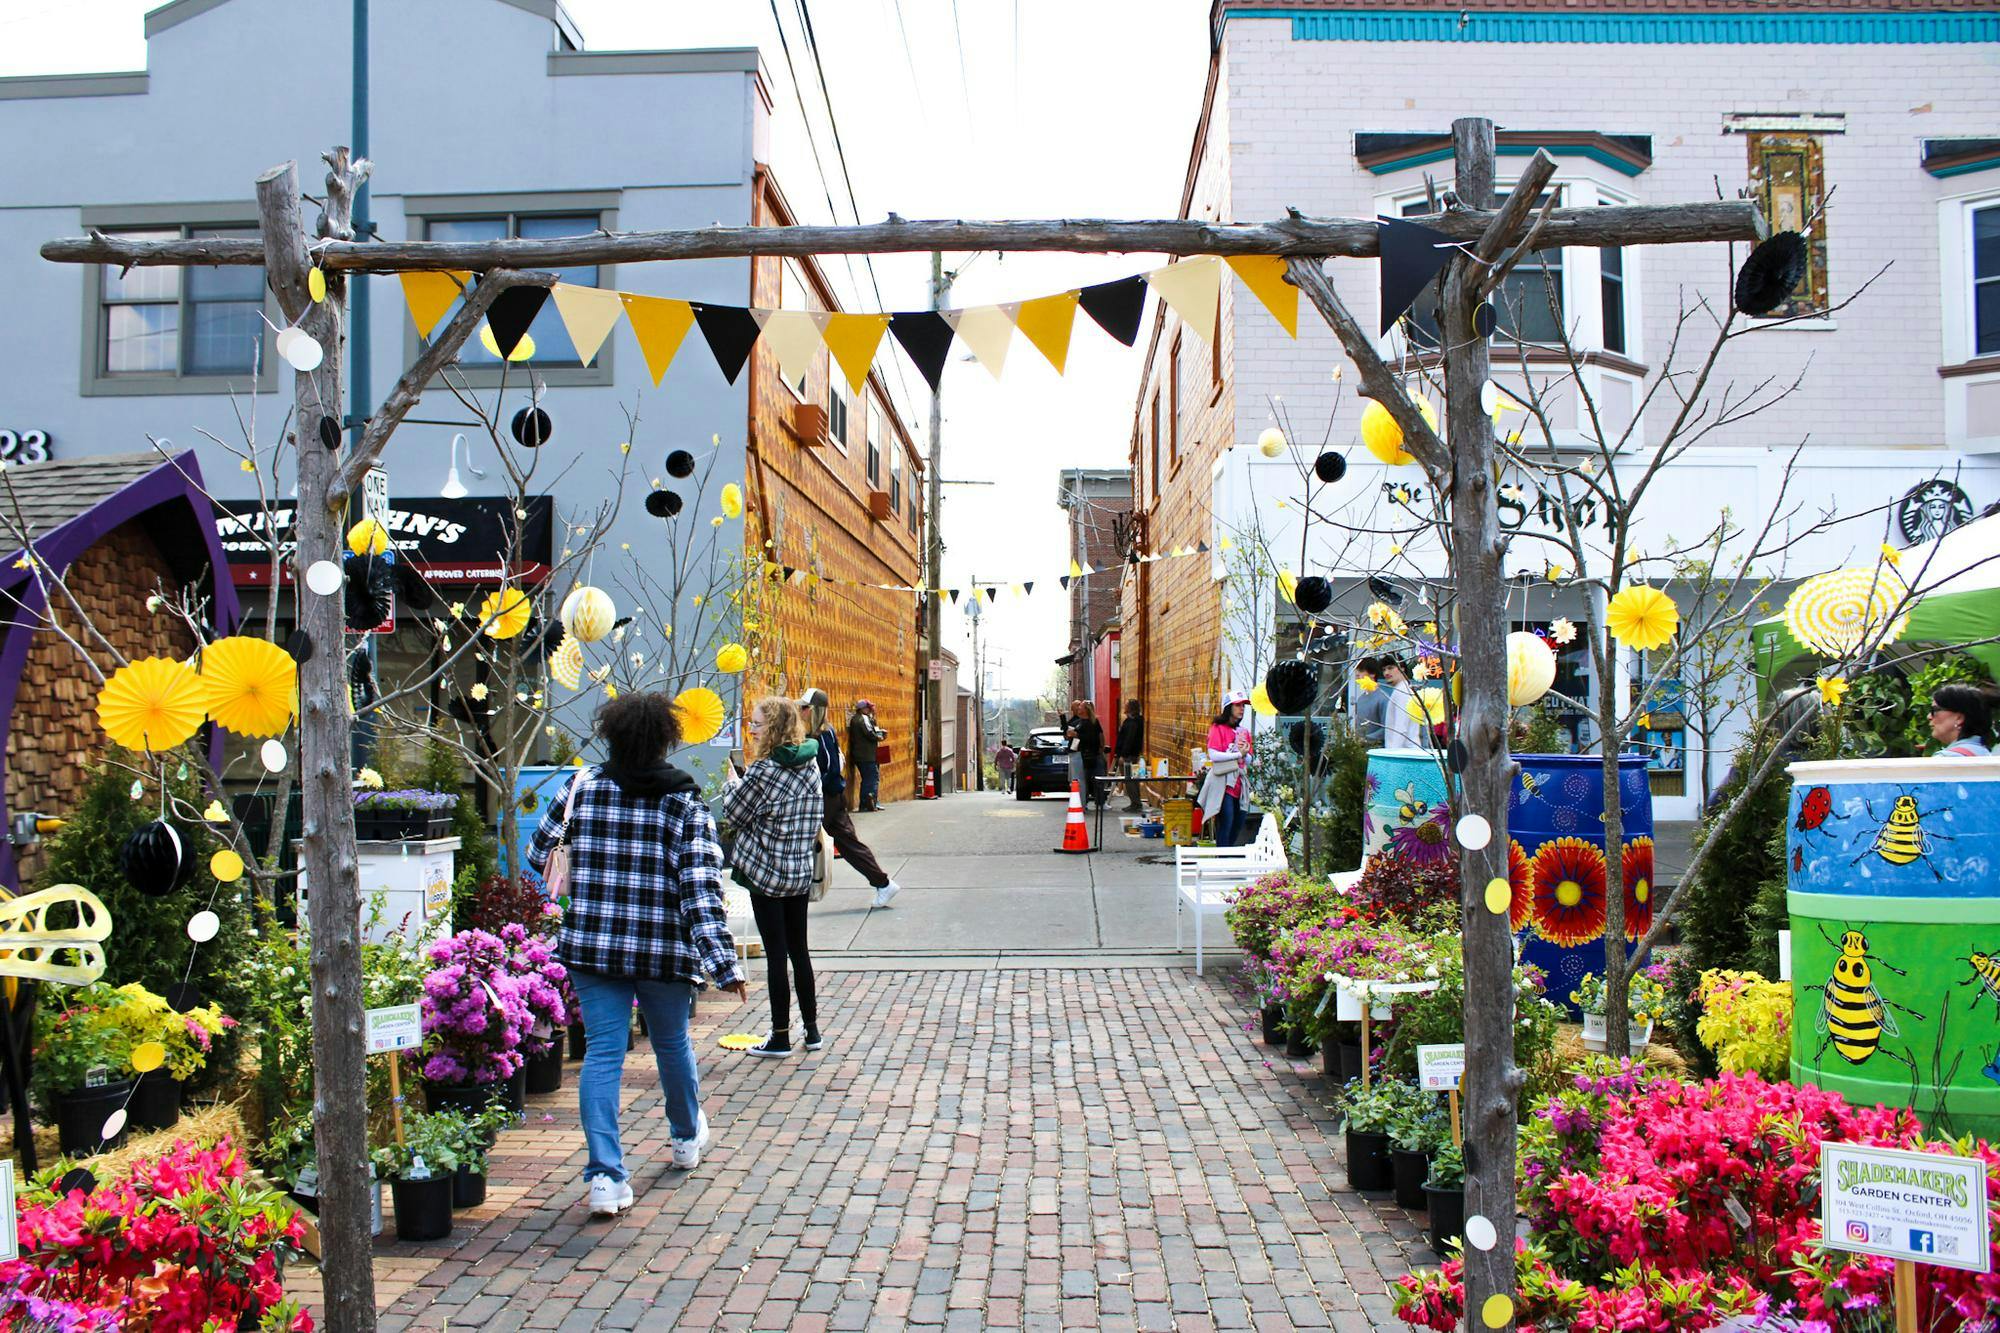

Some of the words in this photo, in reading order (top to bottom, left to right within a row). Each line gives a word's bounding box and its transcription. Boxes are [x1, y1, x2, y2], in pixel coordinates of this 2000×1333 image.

[366, 474, 387, 497] ONE
[424, 569, 464, 579] APPROVED
[465, 569, 504, 579] CATERING
[1837, 1159, 1968, 1209] SHADEMAKERS
[1851, 1186, 1900, 1201] GARDEN
[1902, 1191, 1952, 1208] CENTER
[1848, 1200, 1865, 1209] West
[1934, 1213, 1947, 1221] OH
